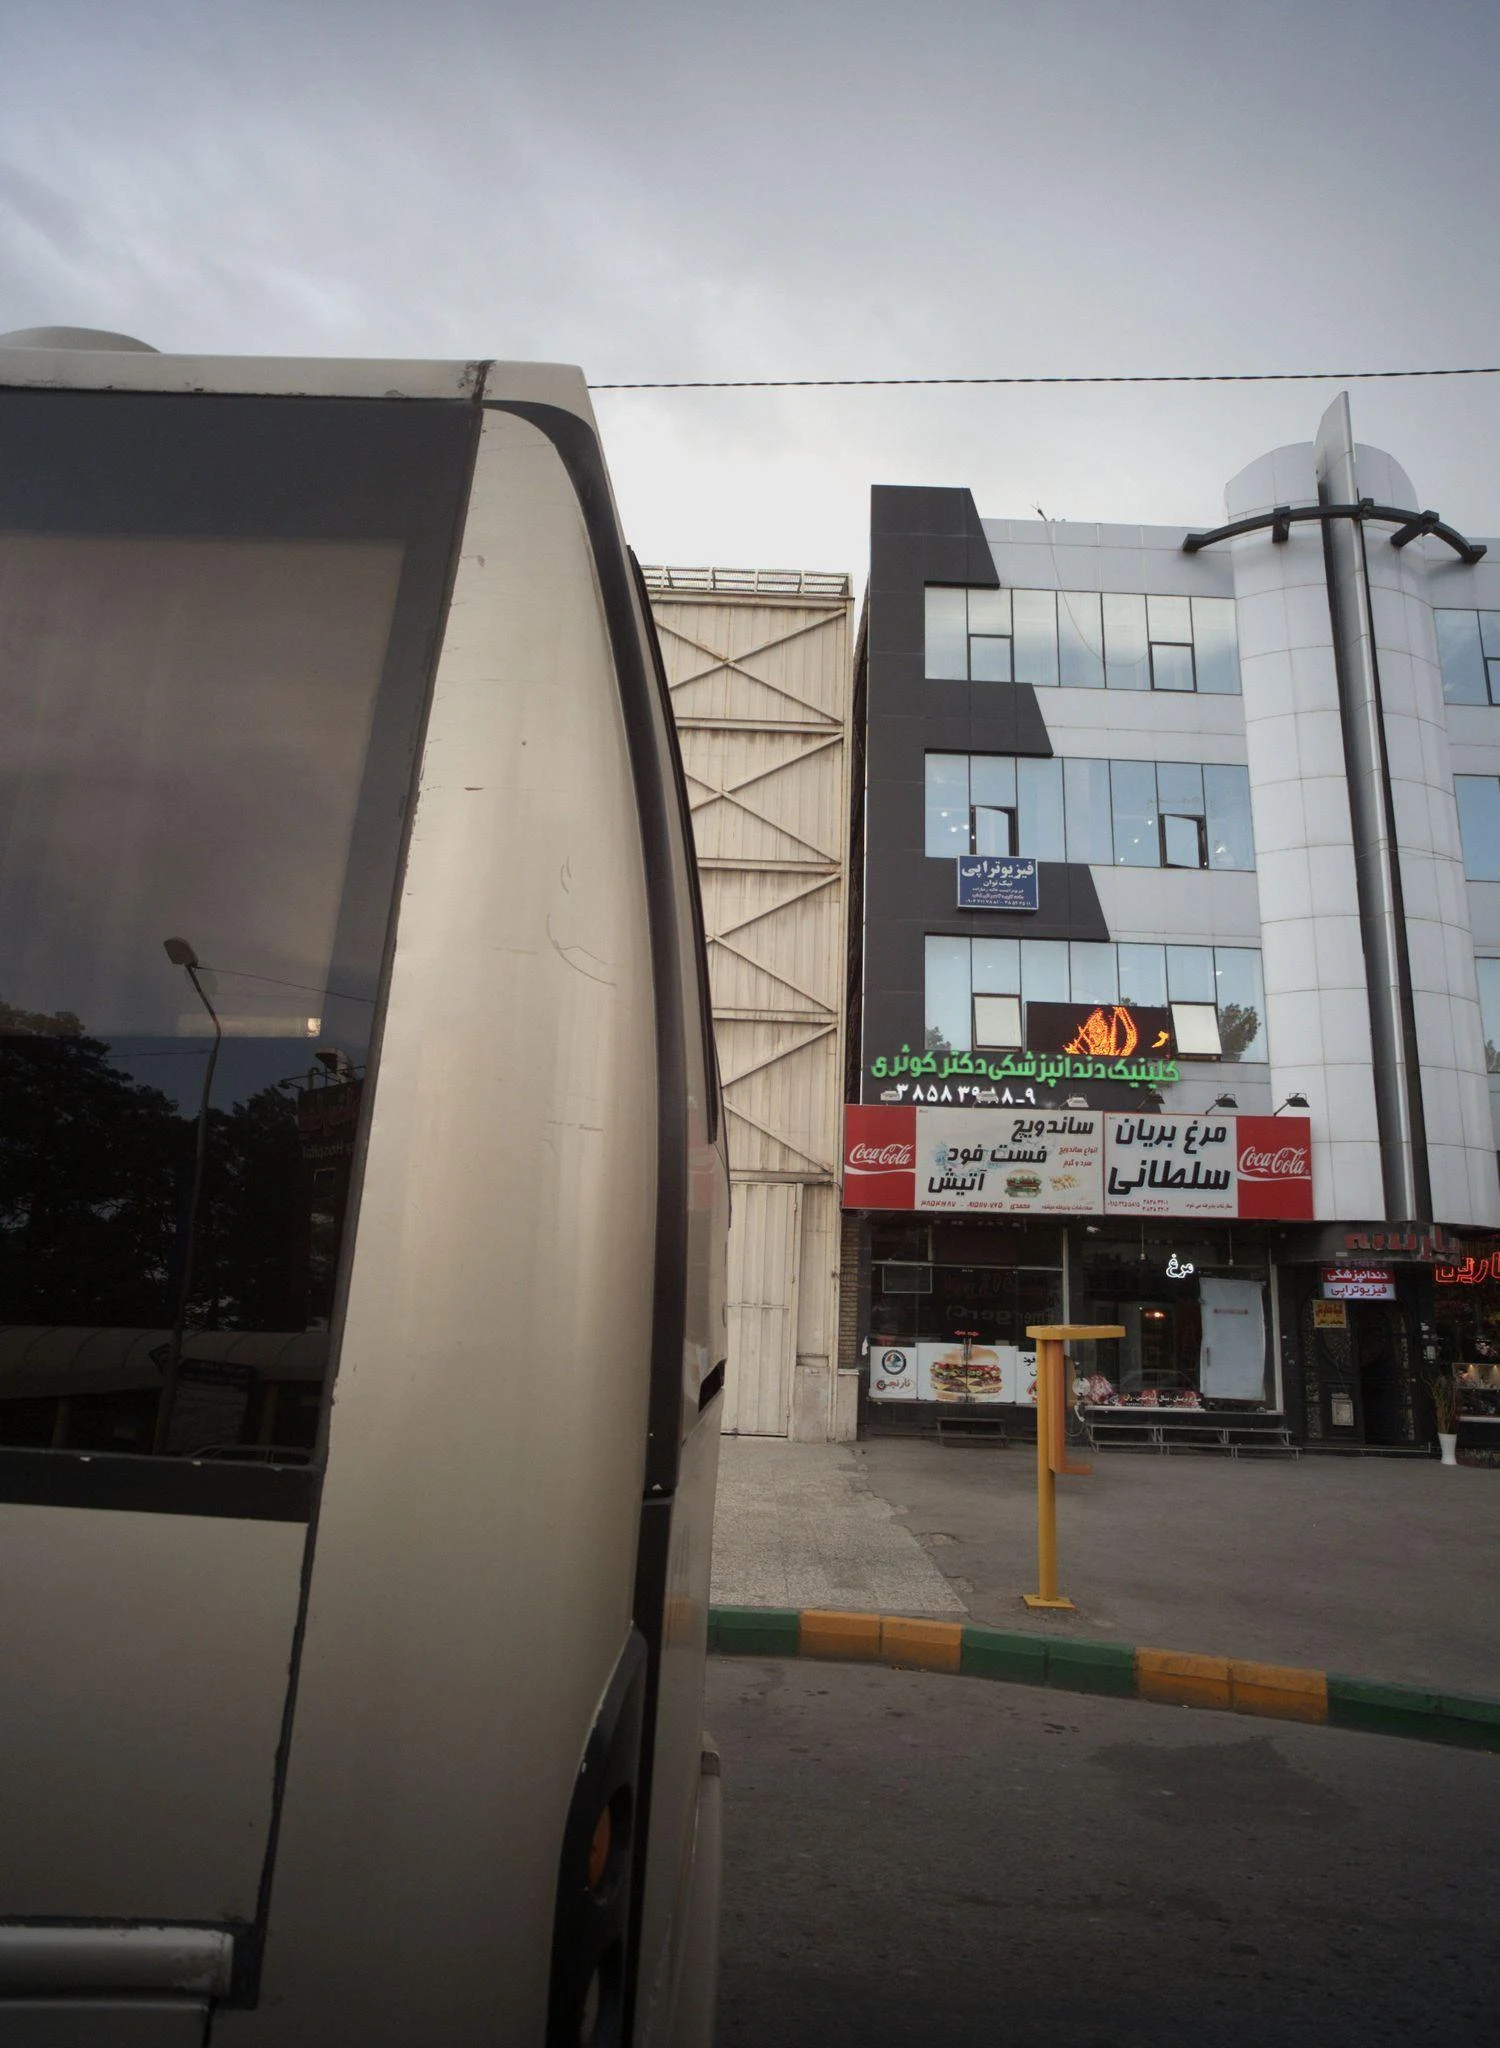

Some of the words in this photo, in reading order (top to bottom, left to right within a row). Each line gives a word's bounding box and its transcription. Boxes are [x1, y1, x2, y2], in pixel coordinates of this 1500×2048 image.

[961, 860, 1034, 879] فیزیوتراپی
[871, 1044, 937, 1078] کوثری
[938, 1050, 987, 1078] دکتر
[988, 1050, 1106, 1087] دندانپزشکی
[1108, 1055, 1180, 1088] کلینیک
[1011, 1116, 1094, 1142] ساندویچ
[1115, 1117, 1177, 1148] بریان
[1183, 1119, 1227, 1155] مرغ
[849, 1143, 914, 1166] Coca-Cola
[947, 1143, 984, 1166] فود
[990, 1143, 1048, 1164] فست
[1238, 1145, 1306, 1175] Coca-Cola
[928, 1169, 986, 1196] آتیش
[1107, 1159, 1231, 1196] سلطانی
[1010, 1202, 1031, 1211] محمدی
[1166, 1253, 1194, 1279] مرغ
[1327, 1269, 1388, 1283] دندانپزشکی
[1331, 1284, 1387, 1298] فیزیوتراپی
